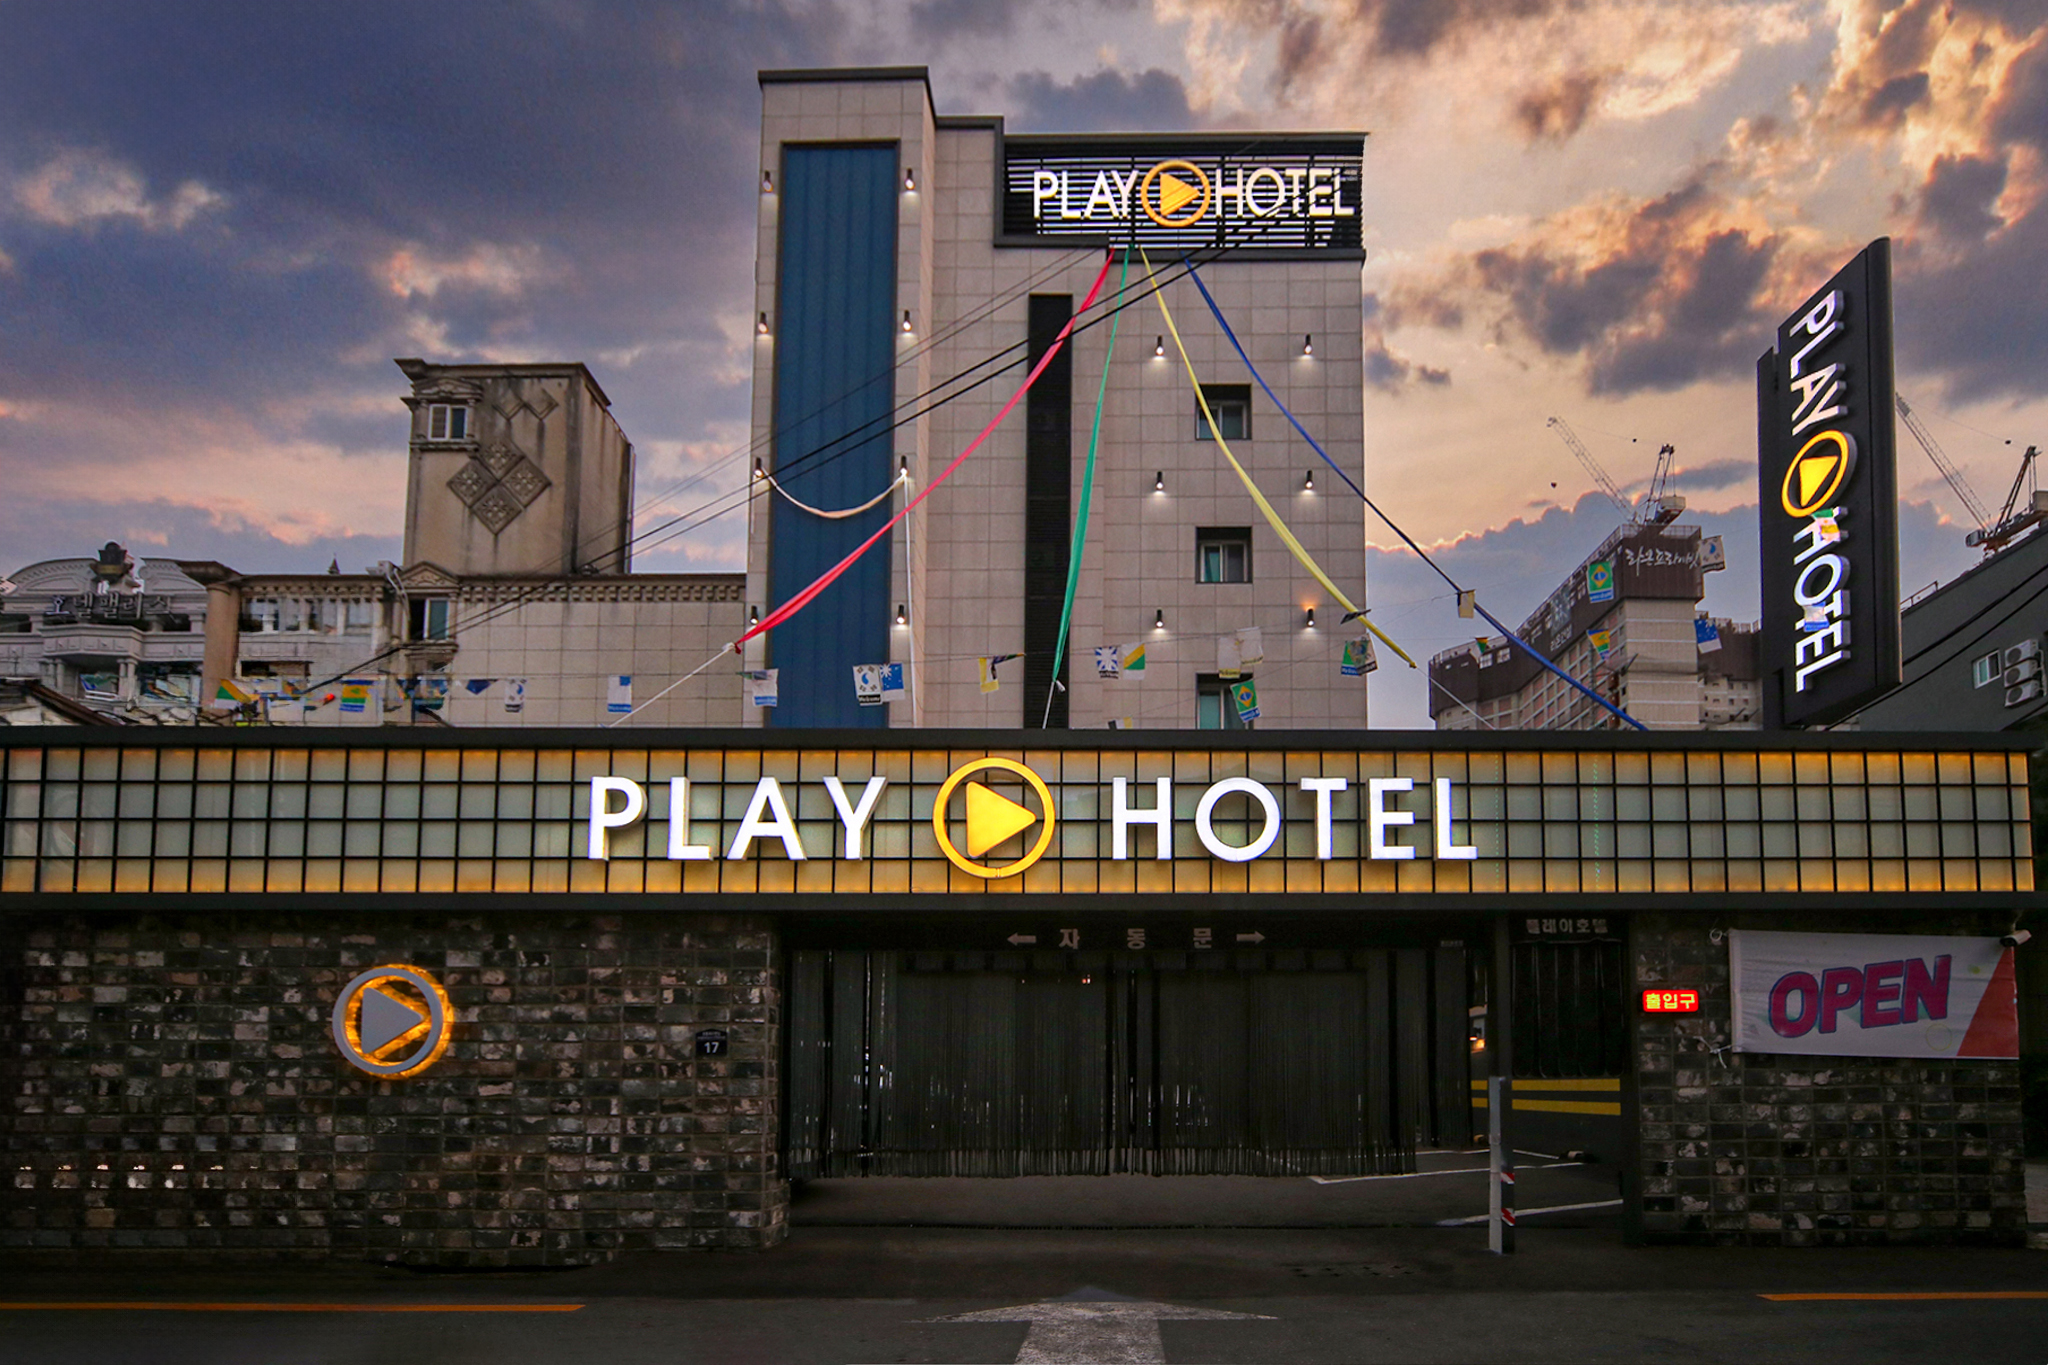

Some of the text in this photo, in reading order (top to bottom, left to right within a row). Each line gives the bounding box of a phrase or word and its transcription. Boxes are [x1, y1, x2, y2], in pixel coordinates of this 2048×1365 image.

[1033, 166, 1355, 219] PLAY HOTEL
[1789, 289, 1847, 437] PLAY
[588, 776, 1478, 862] PLAY HOTEL
[1645, 992, 1696, 1010] 출입구
[1768, 954, 1953, 1039] OPEN
[703, 1041, 720, 1054] 17
